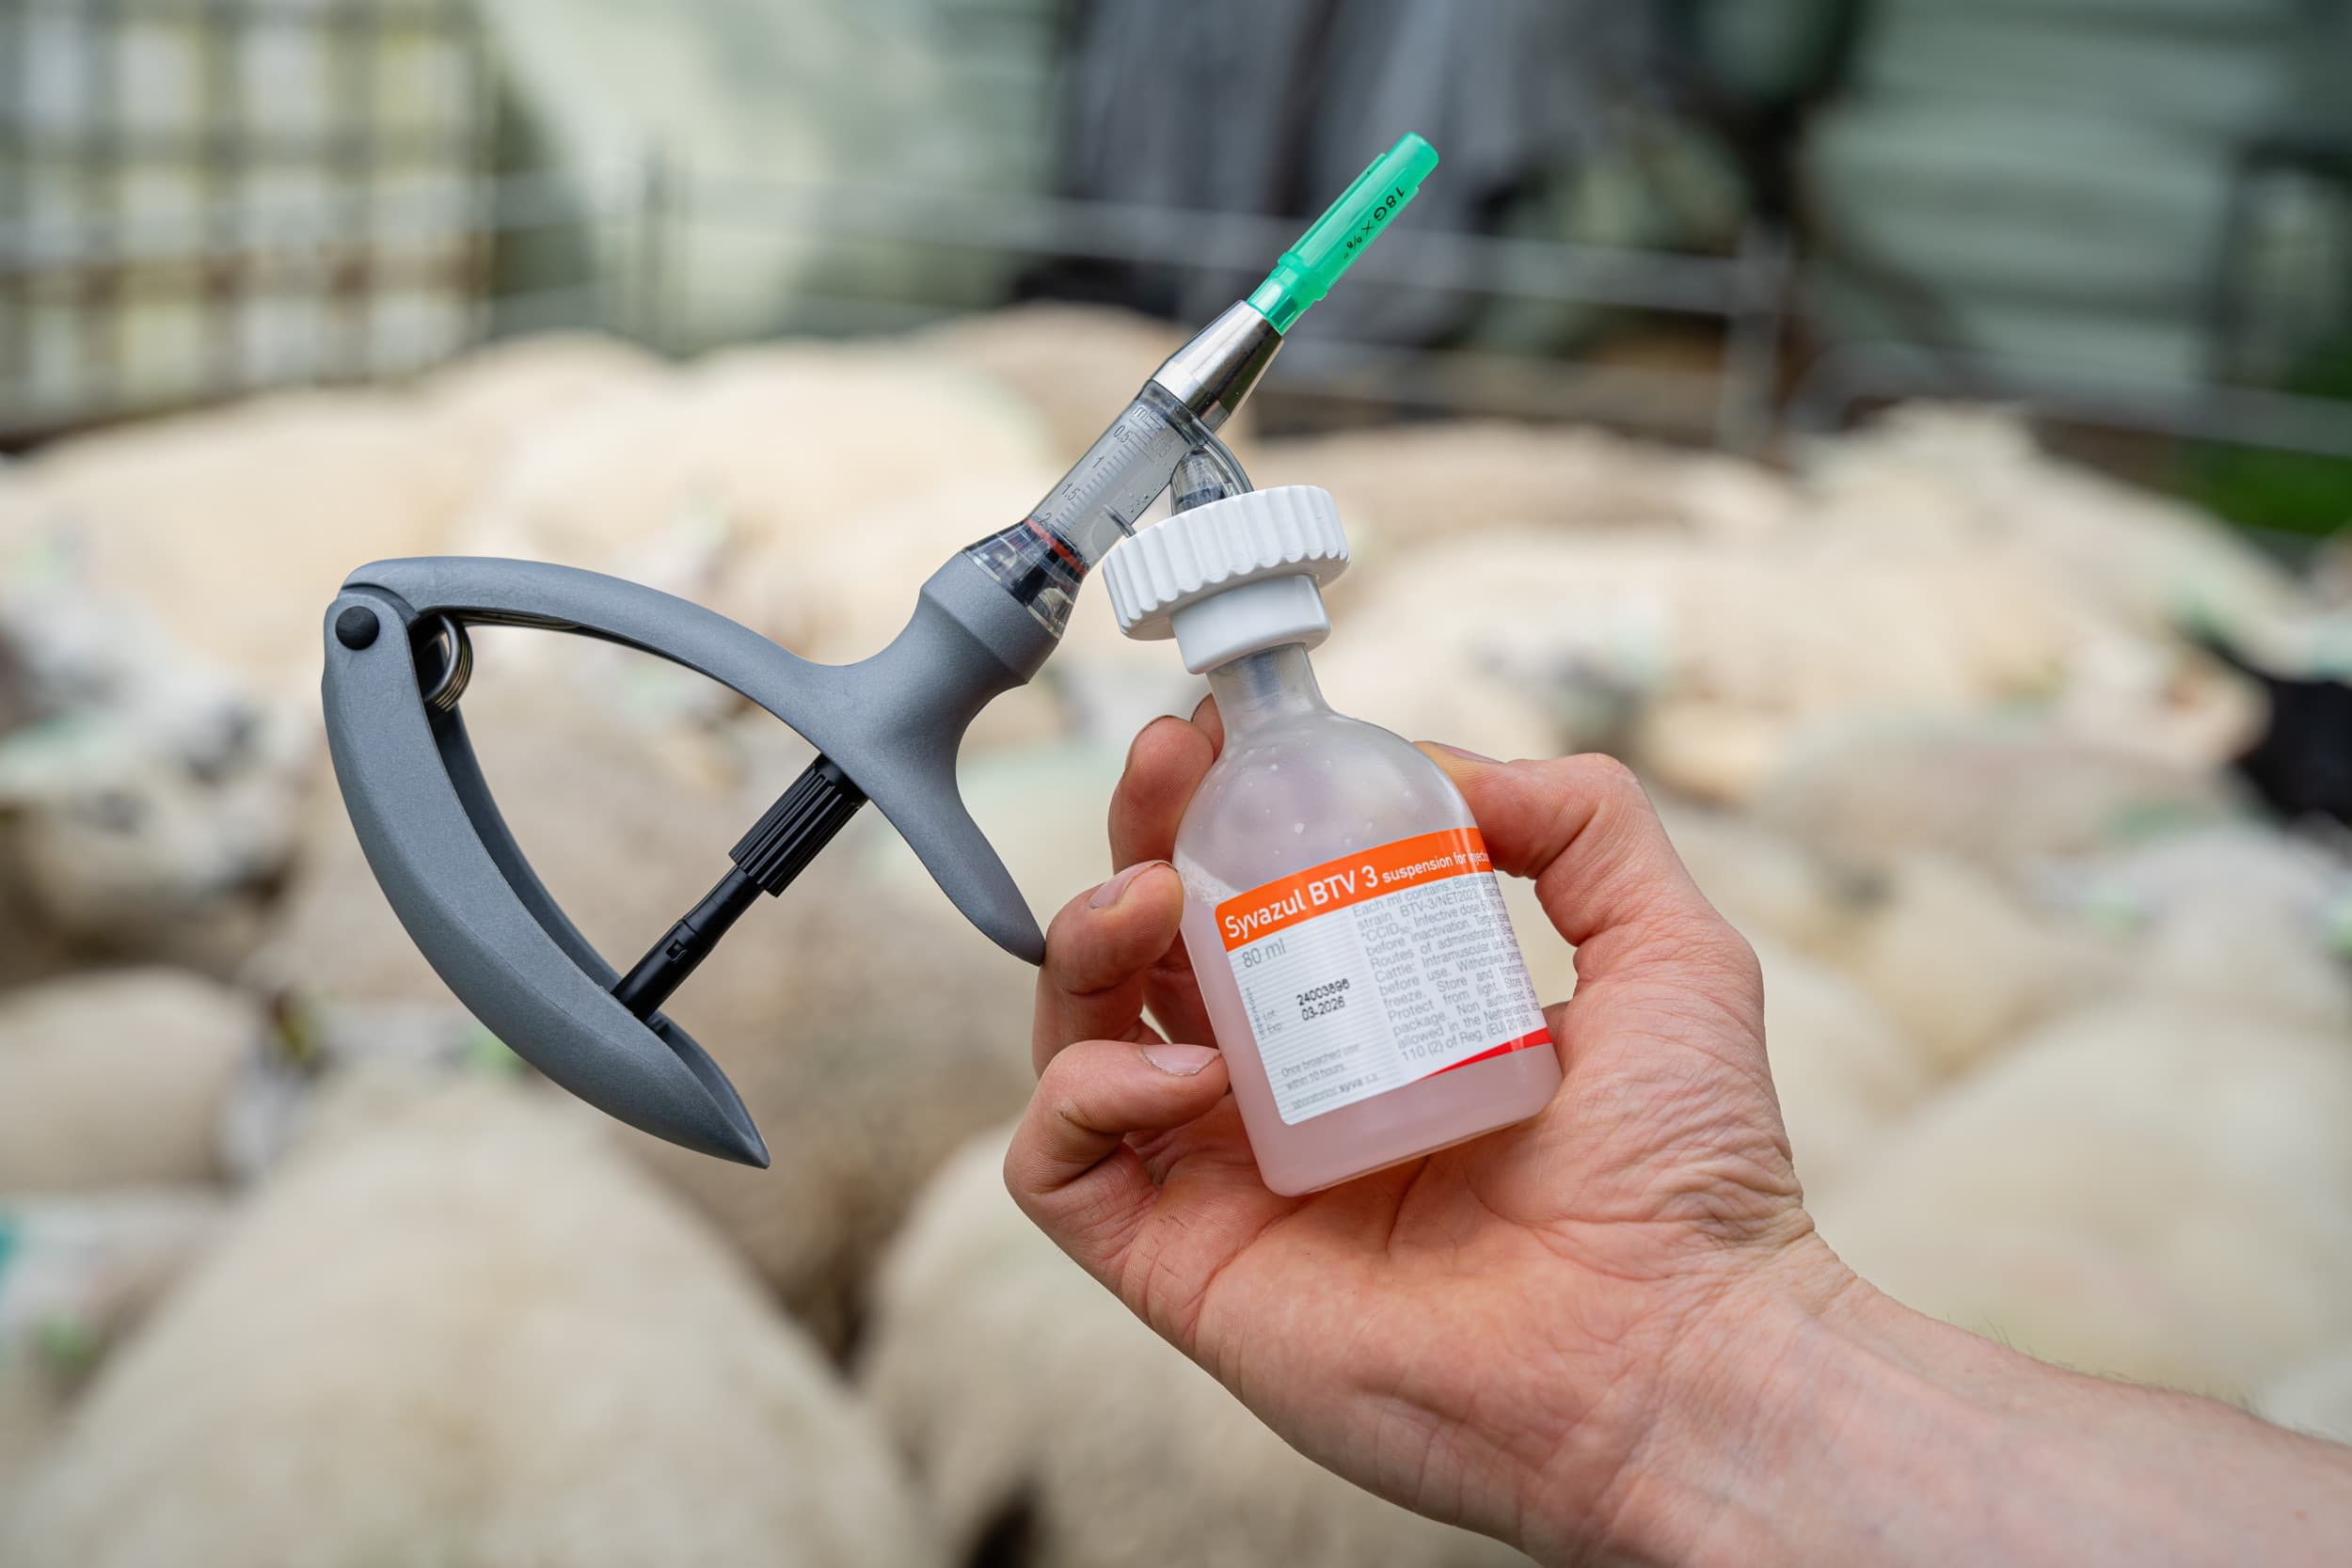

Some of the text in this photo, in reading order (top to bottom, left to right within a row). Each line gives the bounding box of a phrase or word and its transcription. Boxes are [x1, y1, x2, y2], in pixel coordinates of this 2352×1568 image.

[1374, 186, 1405, 222] 18G
[1114, 424, 1133, 443] 0.5
[1061, 482, 1081, 501] 1.5
[1225, 889, 1308, 940] Syvazul
[1308, 870, 1355, 907] BTV
[1361, 864, 1379, 889] 3
[1382, 855, 1453, 884] suspension
[1453, 851, 1467, 865] for
[1353, 897, 1385, 917] Each
[1388, 894, 1402, 908] ml
[1357, 911, 1393, 931] strain
[1413, 909, 1459, 927] Infective
[1460, 903, 1481, 916] dose
[1242, 938, 1286, 968] 80 ml
[1365, 937, 1406, 957] before
[1370, 948, 1415, 970] Routes
[1420, 941, 1433, 955] of
[1375, 963, 1417, 983] Cattle:
[1422, 942, 1488, 968] Intramuscular
[1378, 976, 1421, 996] before
[1426, 968, 1452, 981] use.
[1383, 990, 1427, 1010] freeze.
[1437, 976, 1468, 993] Store
[1476, 968, 1494, 982] and
[1302, 996, 1345, 1021] 03-2026
[1388, 999, 1435, 1023] Protect
[1443, 990, 1470, 1006] from
[1393, 1011, 1450, 1038] package.
[1456, 1001, 1481, 1017] Non
[1398, 1025, 1445, 1050] allowed
[1449, 1022, 1460, 1034] in
[1463, 1015, 1482, 1029] the
[1401, 1044, 1427, 1062] 110
[1427, 1039, 1444, 1055] (2)
[1445, 1034, 1457, 1049] of
[1459, 1029, 1486, 1045] Reg.
